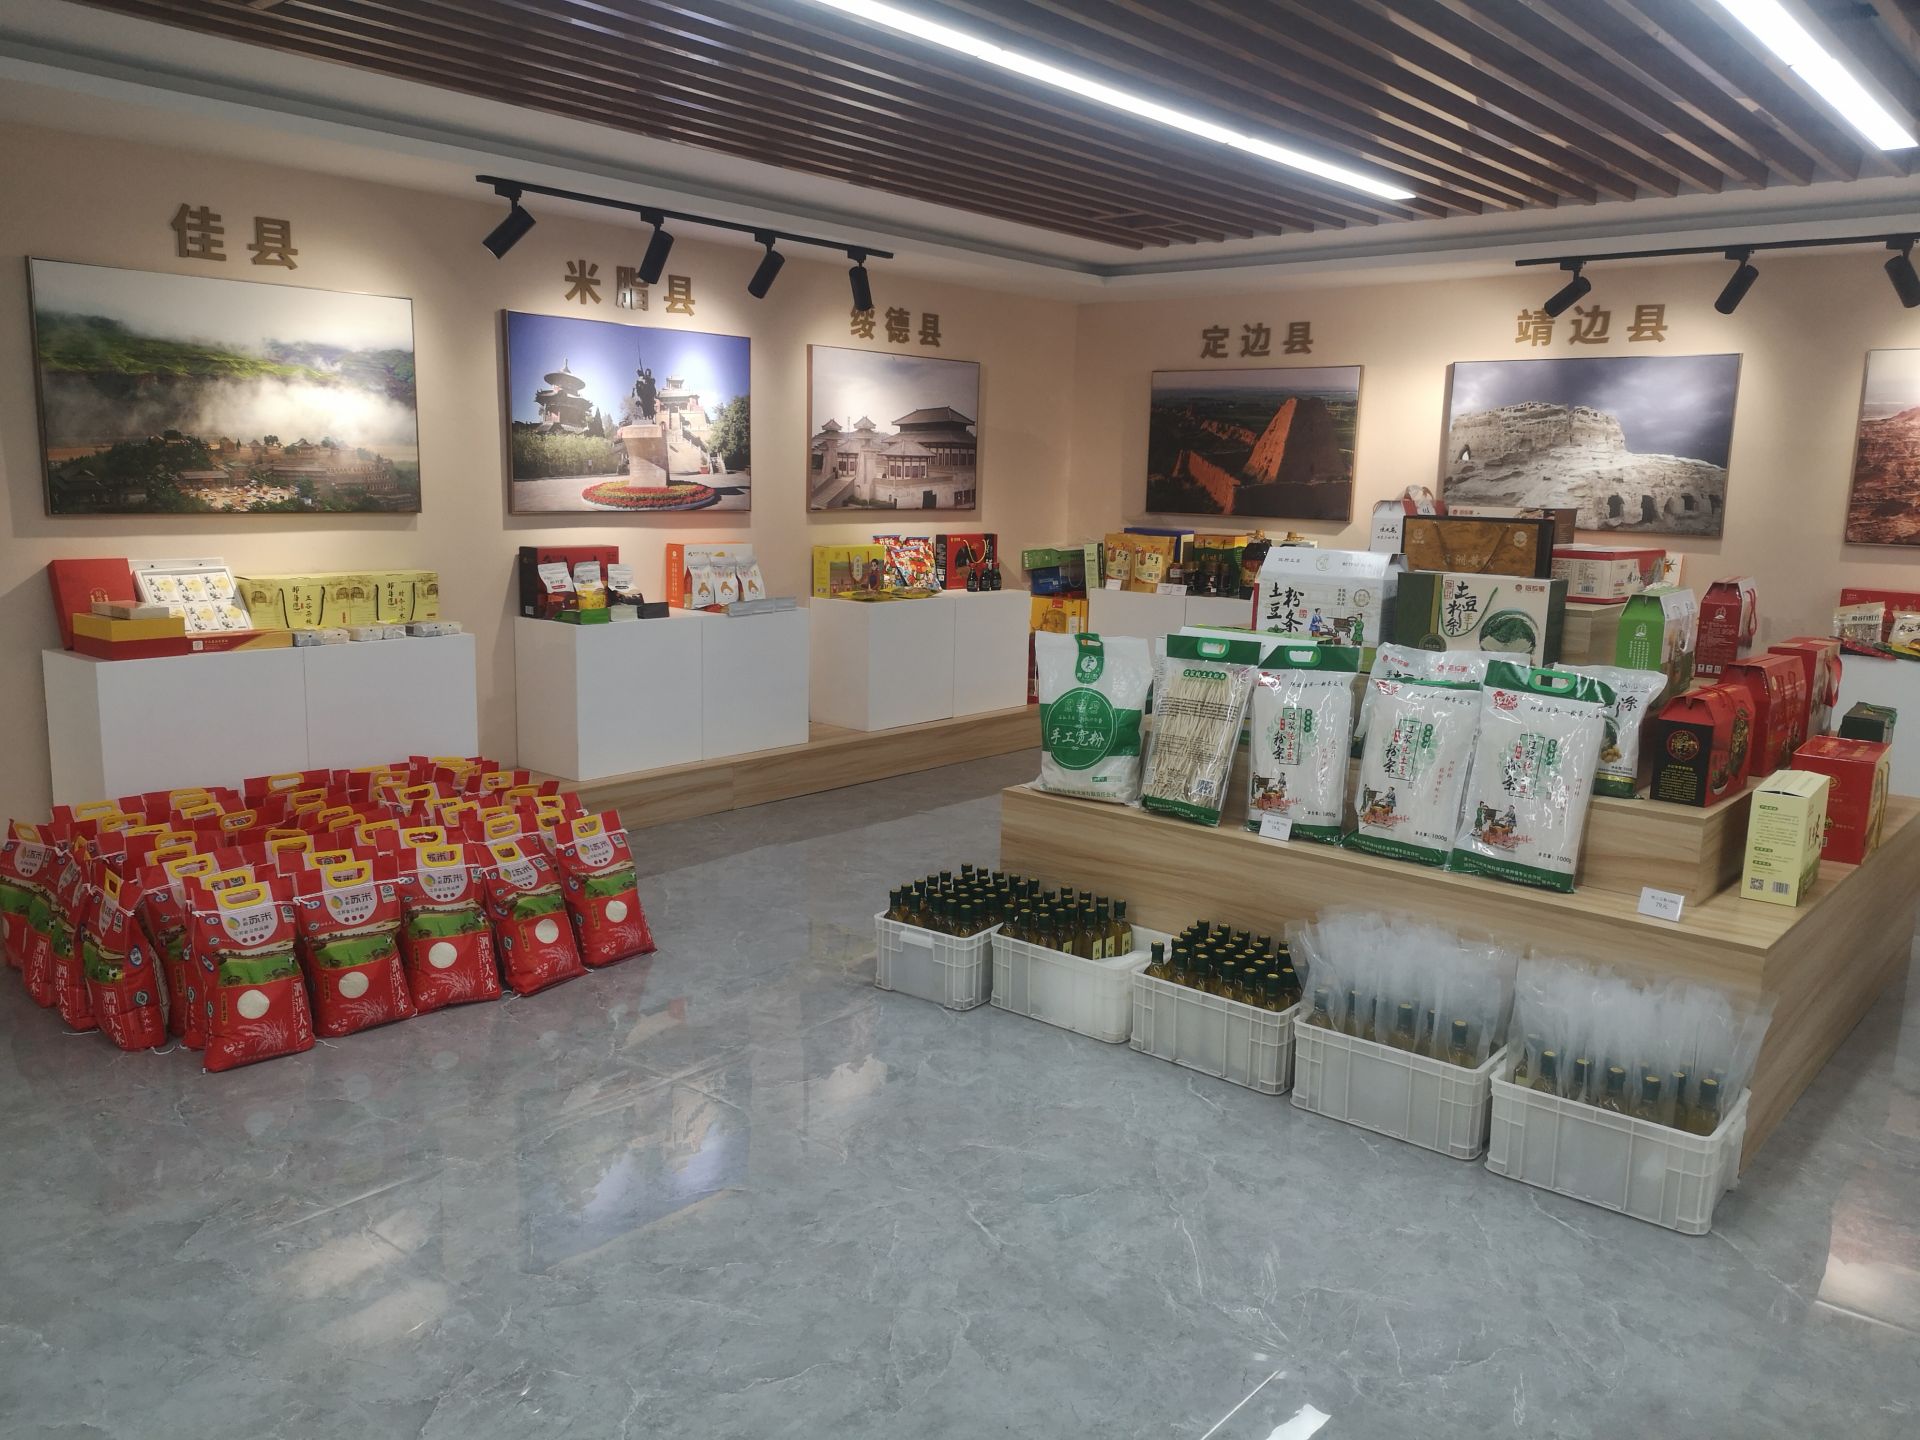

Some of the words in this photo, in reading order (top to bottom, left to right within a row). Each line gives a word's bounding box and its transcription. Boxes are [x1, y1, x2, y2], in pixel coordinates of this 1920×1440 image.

[171, 204, 299, 270] 佳县
[564, 260, 696, 317] 米脂县
[850, 304, 943, 348] 绥德县
[1200, 321, 1314, 358] 定边县
[1516, 304, 1668, 346] 靖边县
[1051, 728, 1105, 748] 手工宽粉
